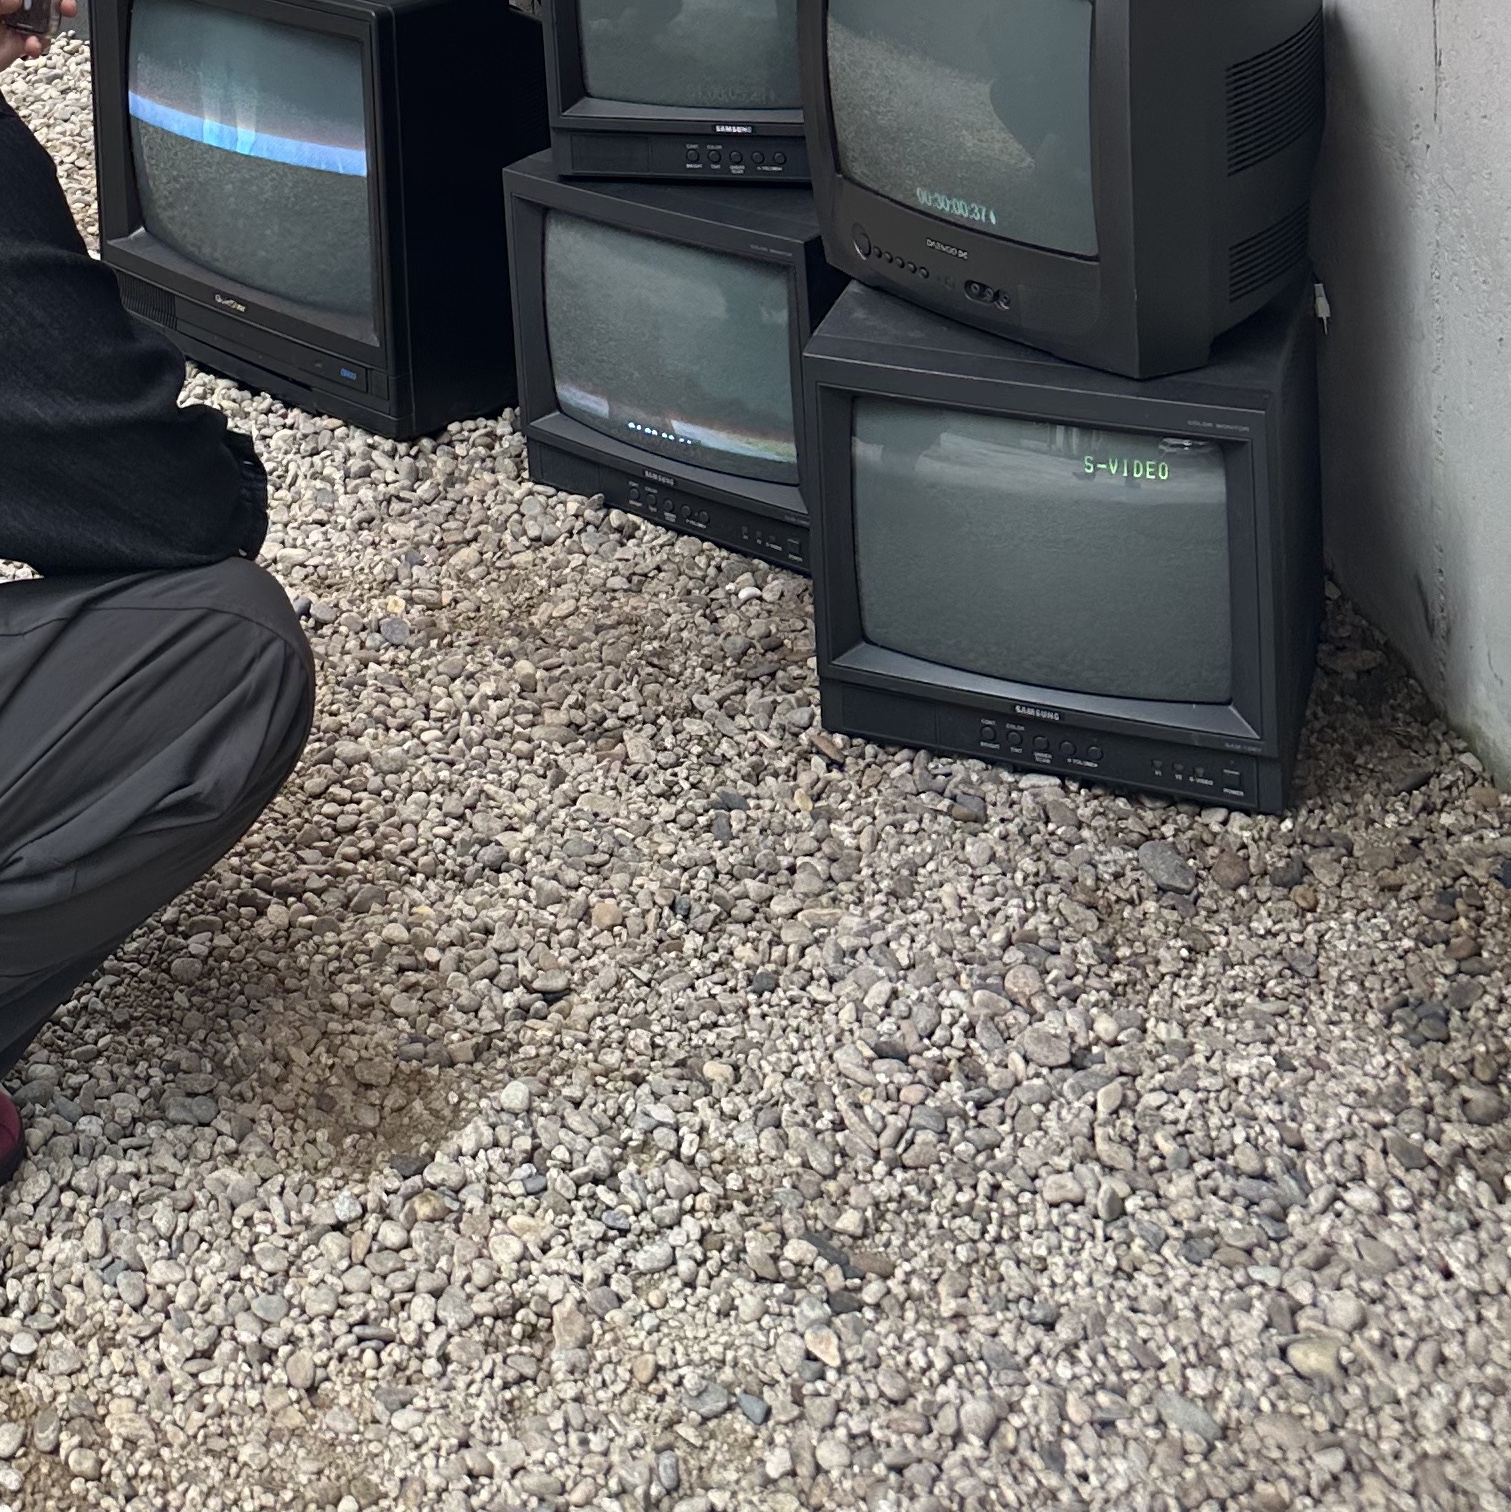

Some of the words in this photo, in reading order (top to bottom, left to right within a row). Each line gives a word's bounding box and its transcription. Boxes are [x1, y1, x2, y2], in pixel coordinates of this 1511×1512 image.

[715, 125, 752, 133] SAMSUNG
[1188, 420, 1213, 428] COLOR
[1215, 423, 1250, 432] MONITOR
[1084, 455, 1169, 480] S-VIDEO
[1015, 705, 1060, 721] SAMSUNG
